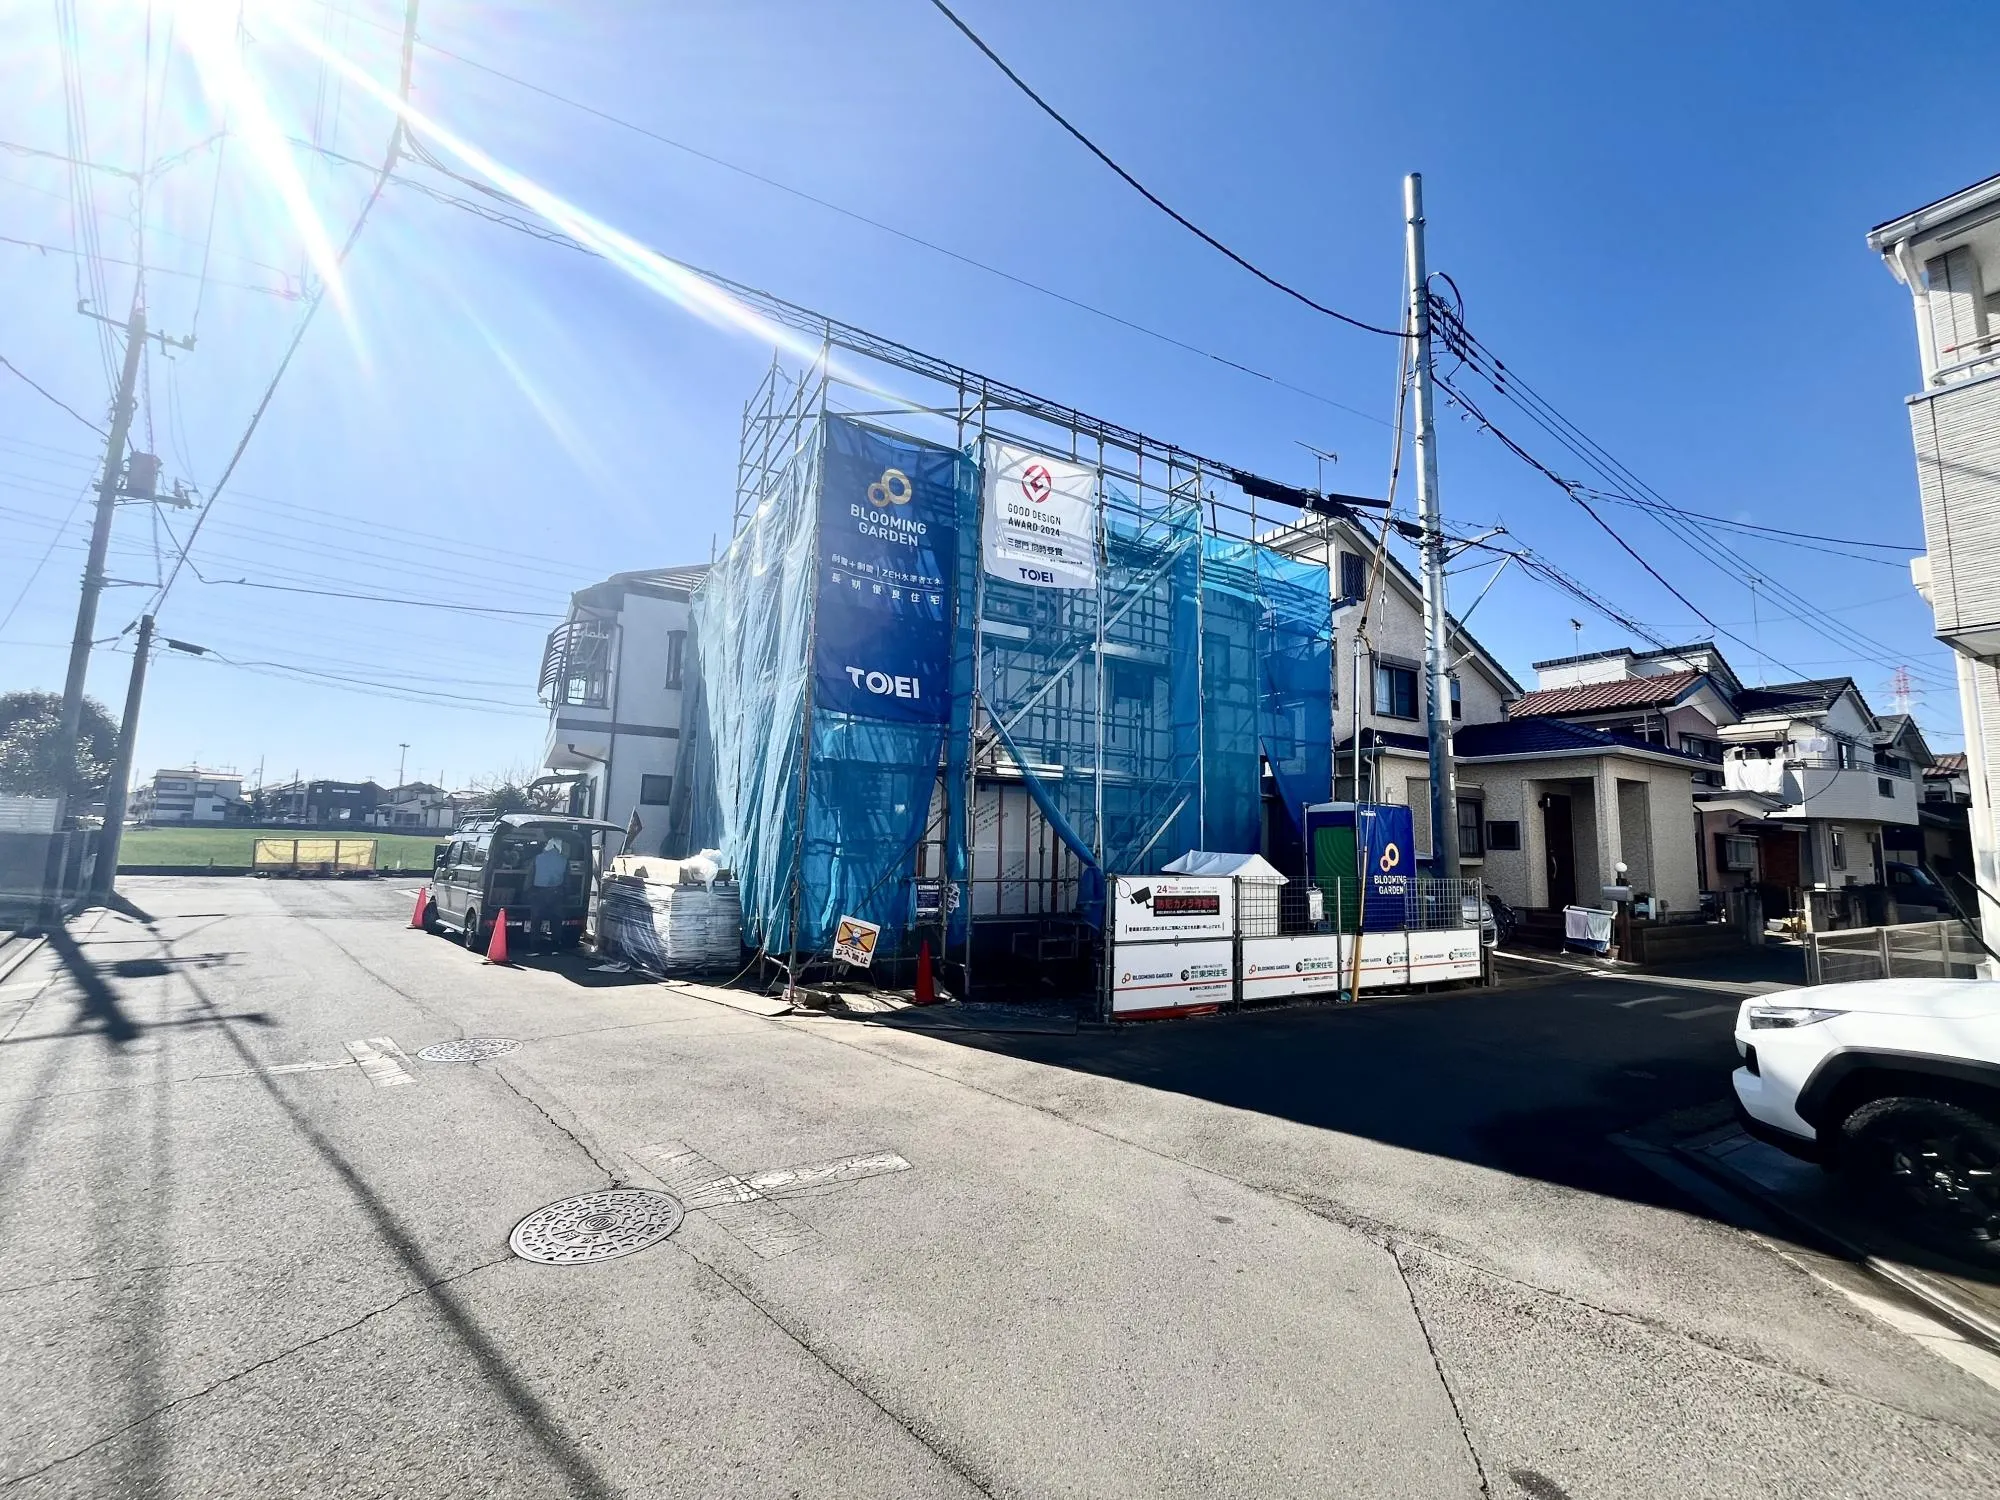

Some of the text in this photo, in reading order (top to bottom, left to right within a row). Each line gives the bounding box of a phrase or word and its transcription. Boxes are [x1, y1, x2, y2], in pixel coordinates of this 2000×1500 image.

[850, 503, 927, 535] BLOOMING
[1007, 503, 1061, 526] GOOD DESIGN
[858, 522, 919, 547] GARDEN
[1008, 517, 1060, 537] AWARD 2024
[1019, 567, 1054, 583] TOEI
[831, 572, 940, 605] 長期優良住宅
[845, 665, 920, 699] TOEI
[1374, 875, 1407, 885] BLOOMING
[1156, 885, 1168, 894] 24
[1379, 886, 1404, 895] GARDEN
[835, 948, 869, 965] 立入禁止
[1199, 968, 1228, 978] 東栄住宅
